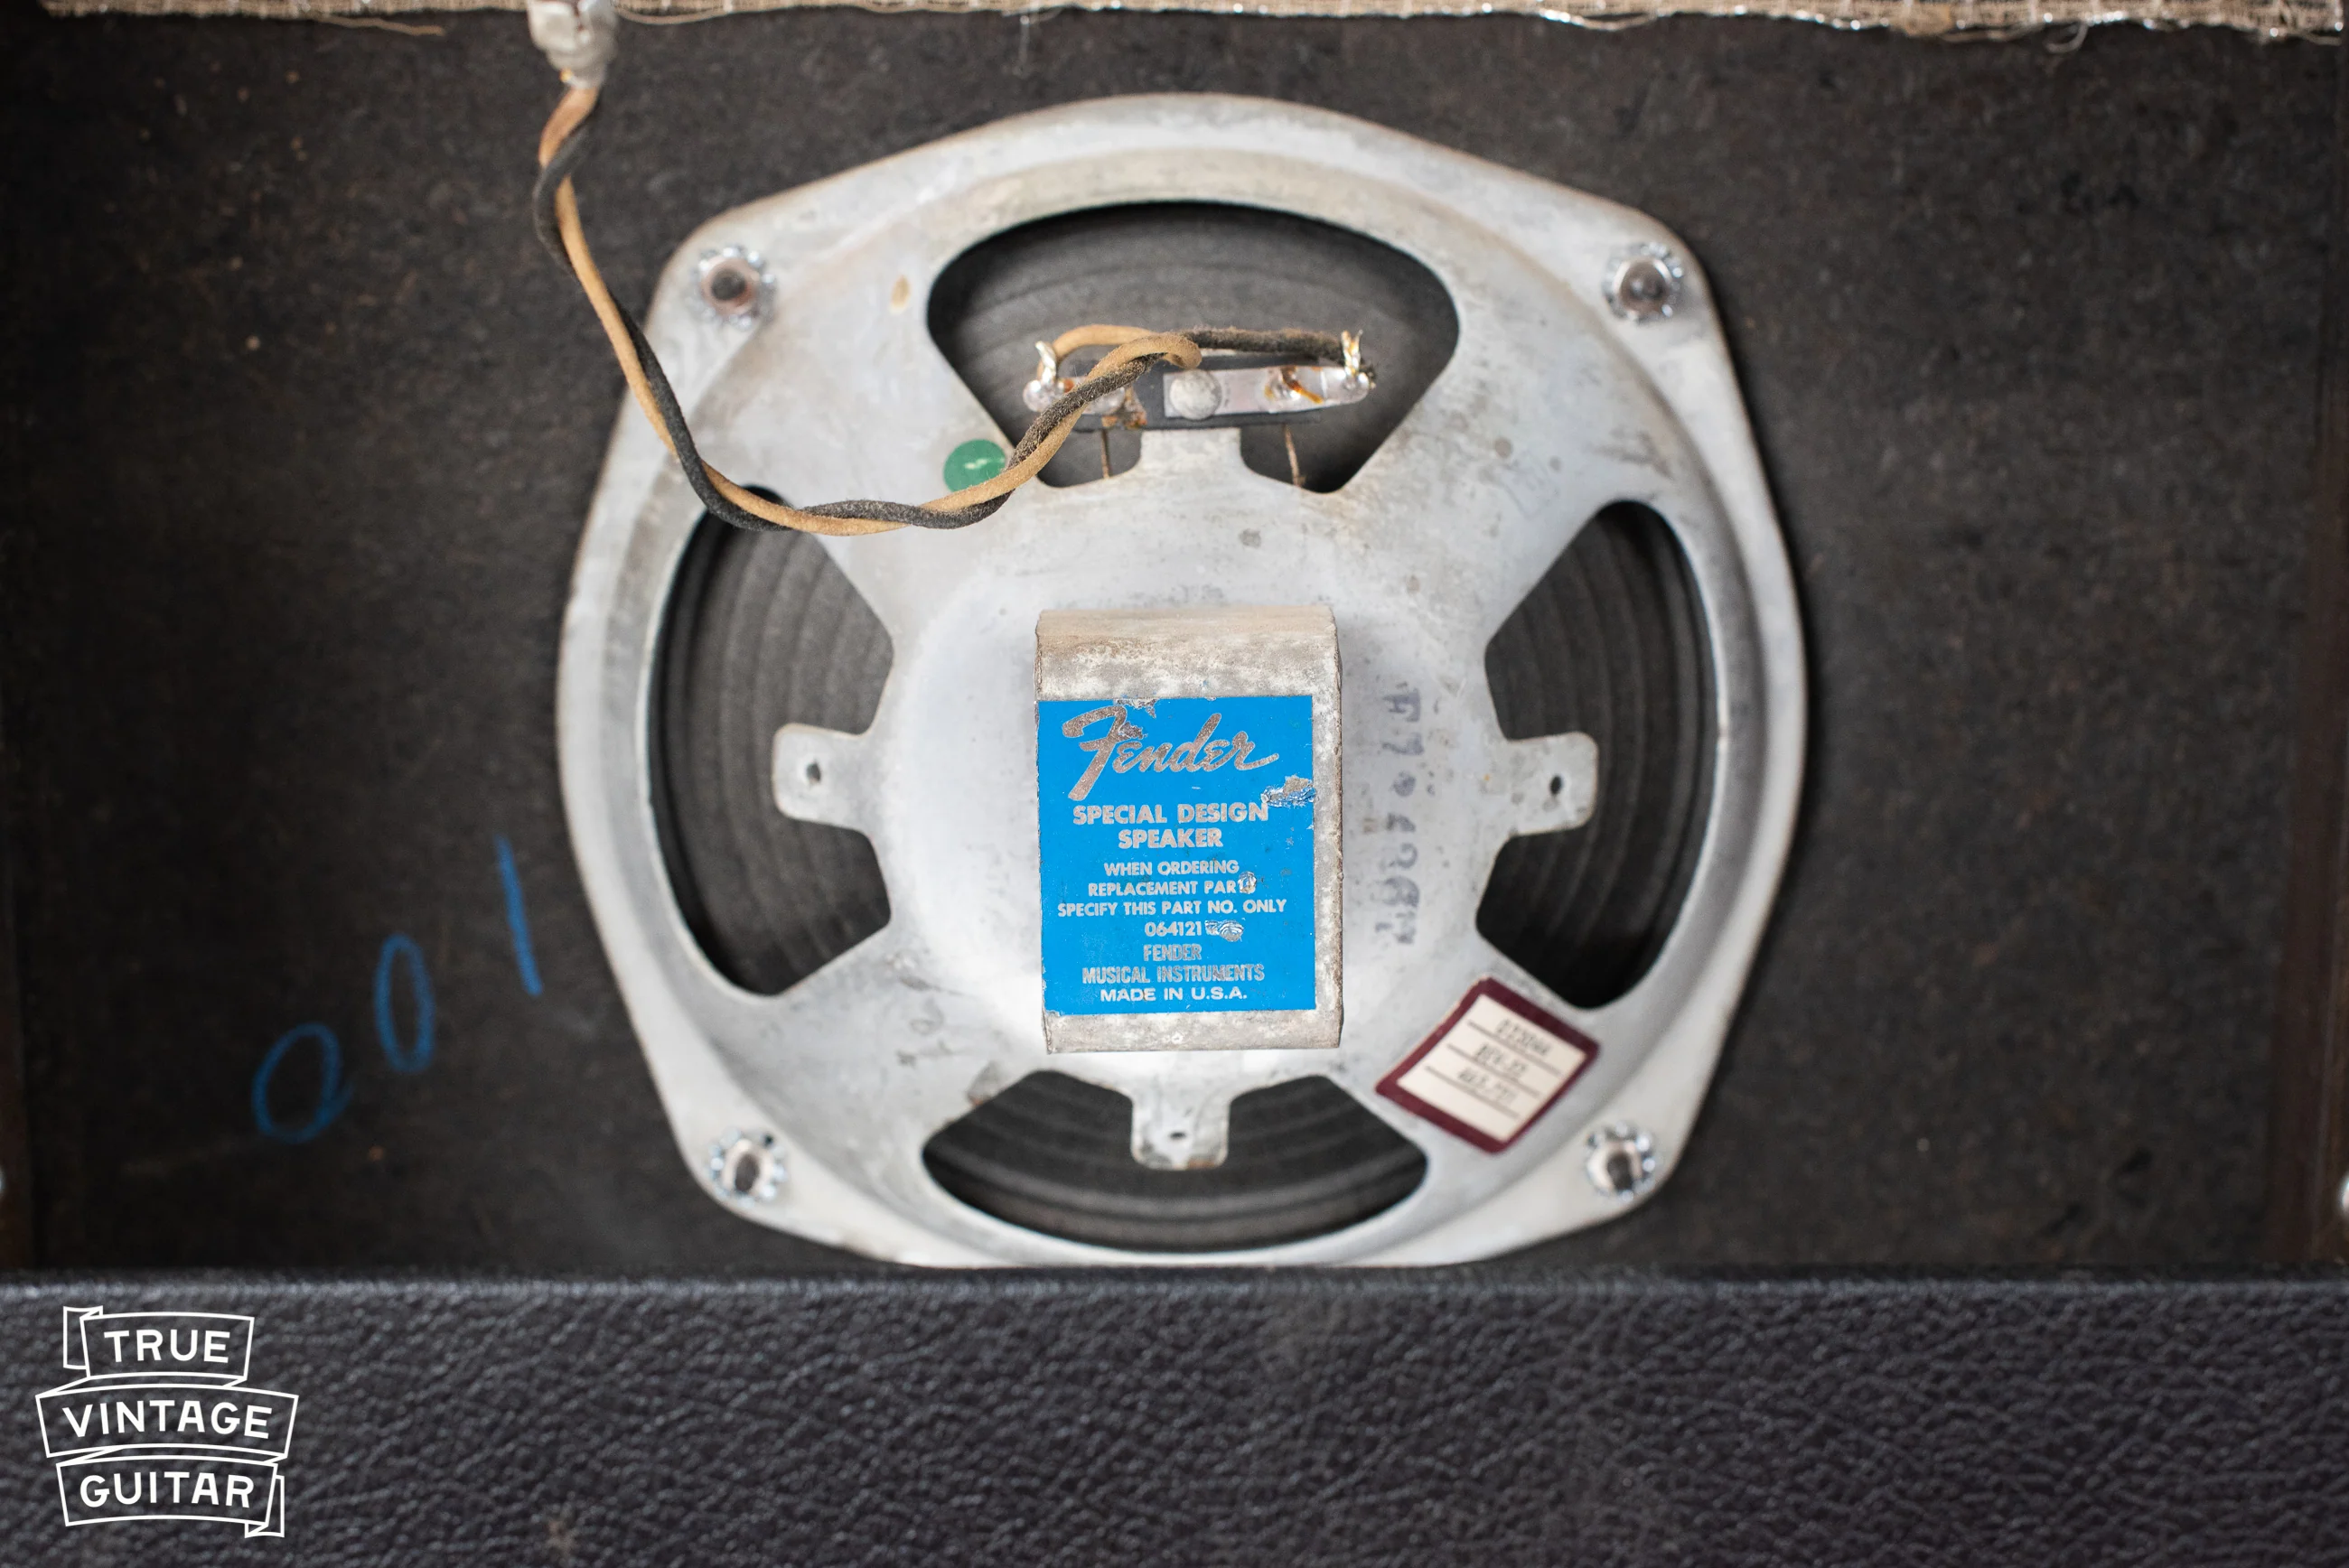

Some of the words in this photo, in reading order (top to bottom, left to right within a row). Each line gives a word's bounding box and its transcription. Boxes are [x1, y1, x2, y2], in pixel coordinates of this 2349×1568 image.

[1063, 705, 1279, 801] Fender
[1073, 805, 1167, 825] SPECIAL
[1178, 803, 1269, 823] DESIGN
[1118, 827, 1223, 849] SPEAKER
[1104, 862, 1152, 876] WHEN
[1157, 860, 1240, 877] ORDERING
[1089, 881, 1198, 896] REPLACEMENT
[1058, 902, 1118, 917] SPECIFY
[1123, 901, 1156, 915] THIS
[1162, 901, 1201, 914] PART
[1208, 900, 1237, 914] NO.
[1243, 900, 1287, 913] ONLY
[1144, 944, 1202, 961] FENDER
[1082, 966, 1150, 984] MUSICAL
[1157, 964, 1265, 982] INSTRUMENTS
[1100, 988, 1156, 1002] MADE
[1164, 988, 1183, 1000] IN
[1192, 986, 1247, 1000] U.S.A.
